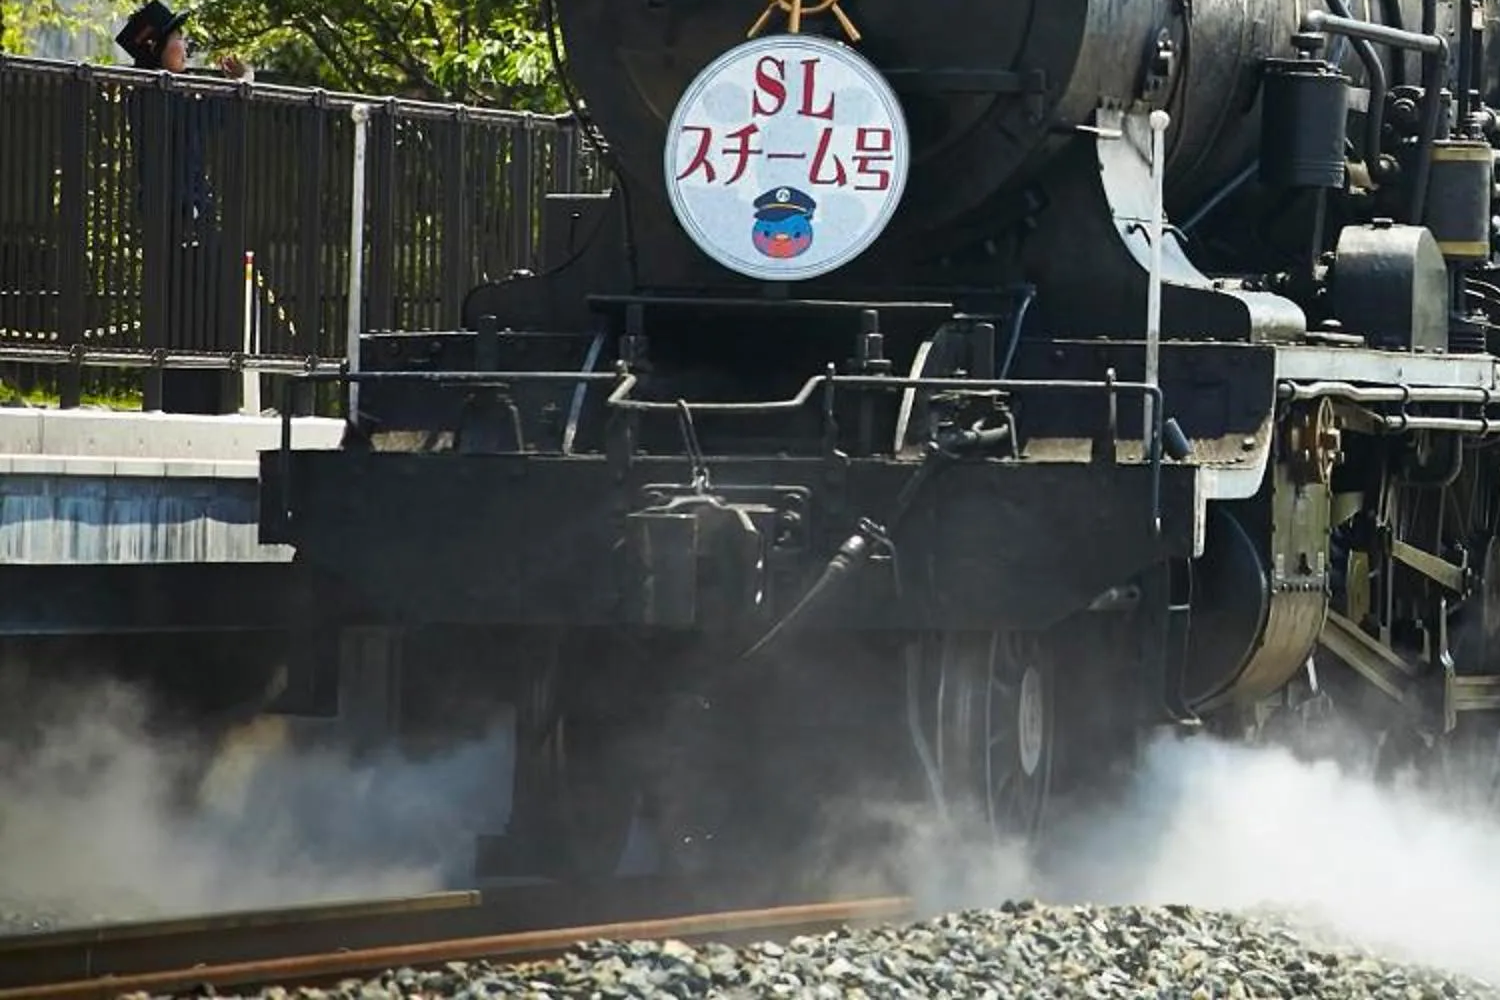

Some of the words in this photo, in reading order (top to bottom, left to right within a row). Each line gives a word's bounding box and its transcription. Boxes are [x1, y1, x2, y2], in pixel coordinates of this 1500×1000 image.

[752, 55, 835, 120] SL
[676, 123, 893, 191] スチーム号
